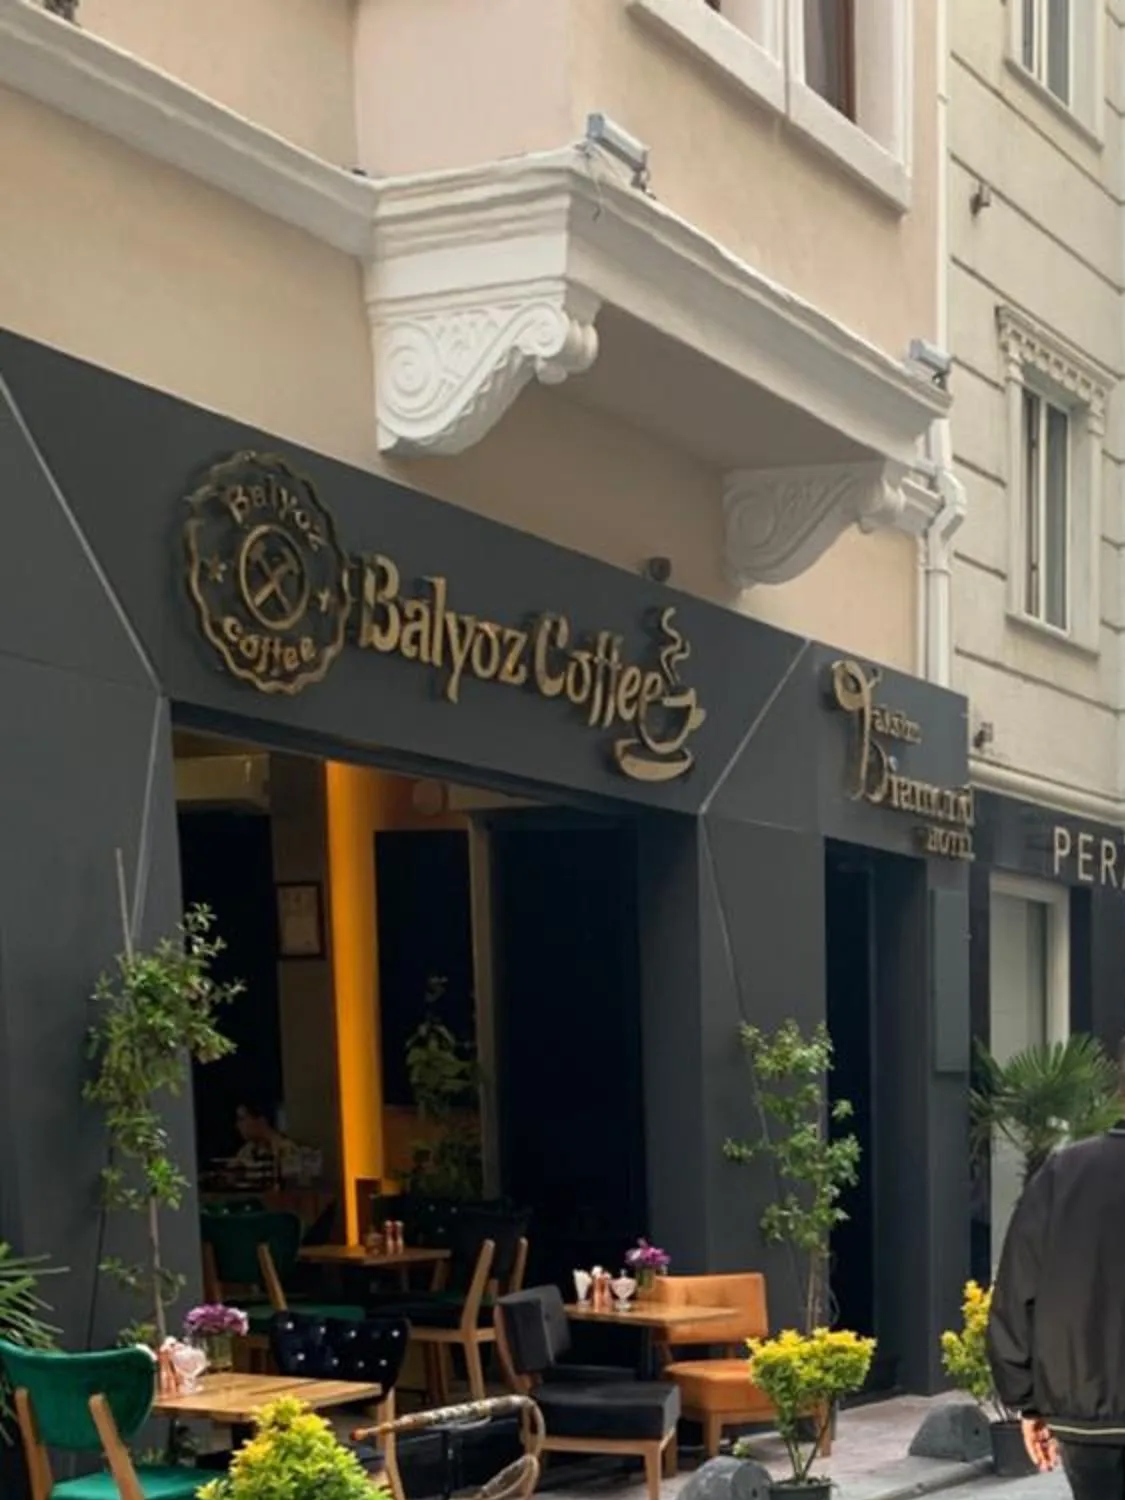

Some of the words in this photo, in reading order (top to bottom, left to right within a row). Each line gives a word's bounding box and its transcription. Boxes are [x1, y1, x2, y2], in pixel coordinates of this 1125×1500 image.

[228, 474, 327, 552] Balyoz
[359, 553, 528, 703] Balyoz
[534, 612, 666, 727] Coffee
[862, 740, 975, 828] Diamond
[926, 825, 976, 861] HOTEL
